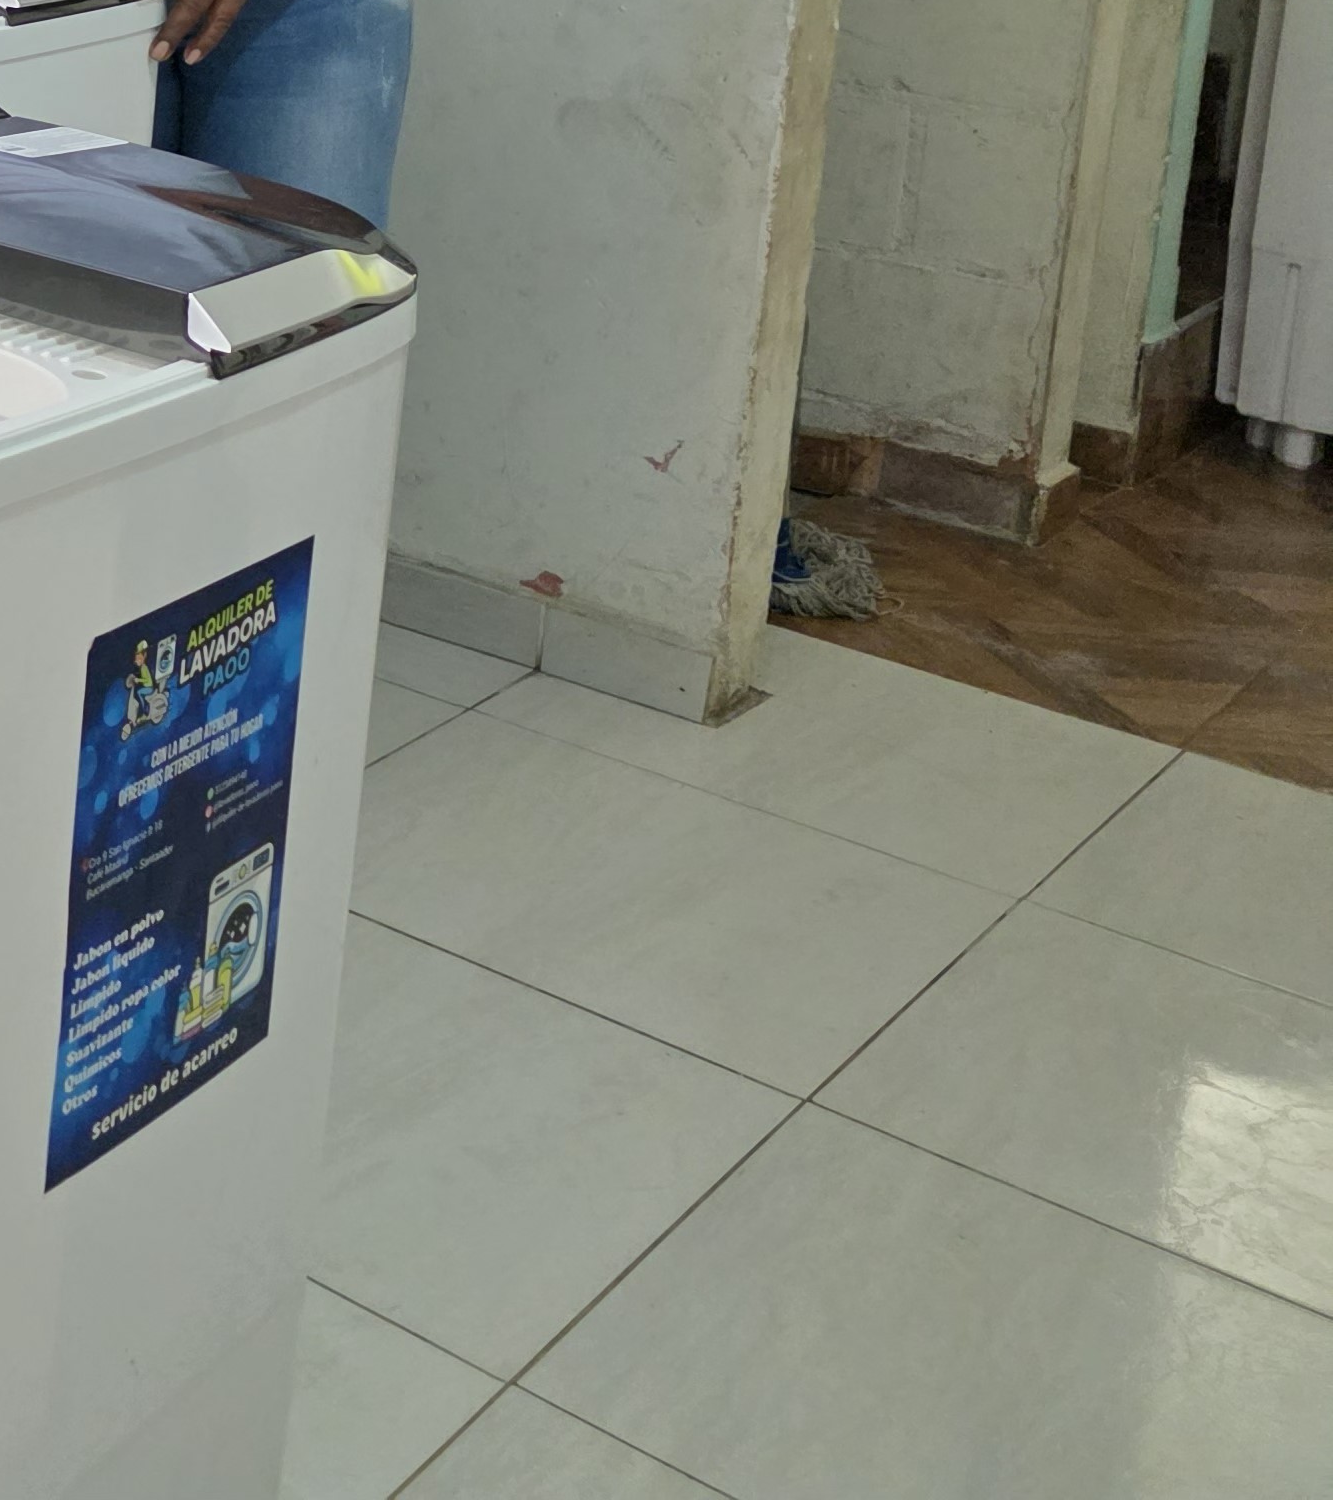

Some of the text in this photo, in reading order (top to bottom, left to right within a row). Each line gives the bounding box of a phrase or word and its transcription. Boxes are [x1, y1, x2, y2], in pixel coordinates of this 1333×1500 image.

[186, 579, 274, 652] ALQUILER DE
[179, 601, 276, 685] LAVADORA
[118, 767, 163, 807] OFRECEMOS
[164, 743, 210, 782] DETERGENTE
[211, 733, 229, 756] PARA
[230, 727, 240, 745] TU
[240, 713, 264, 740] HOGAR
[151, 746, 167, 768] CON
[168, 740, 177, 760] LA
[179, 727, 203, 756] MEJOR
[139, 844, 174, 870] Santander
[114, 929, 129, 946] en
[130, 909, 165, 940] polvo
[121, 985, 149, 1012] ropa
[150, 964, 182, 991] color
[66, 1017, 133, 1067] Suavizante
[62, 1084, 98, 1115] Otros
[91, 1027, 238, 1140] servicio de acarreo
